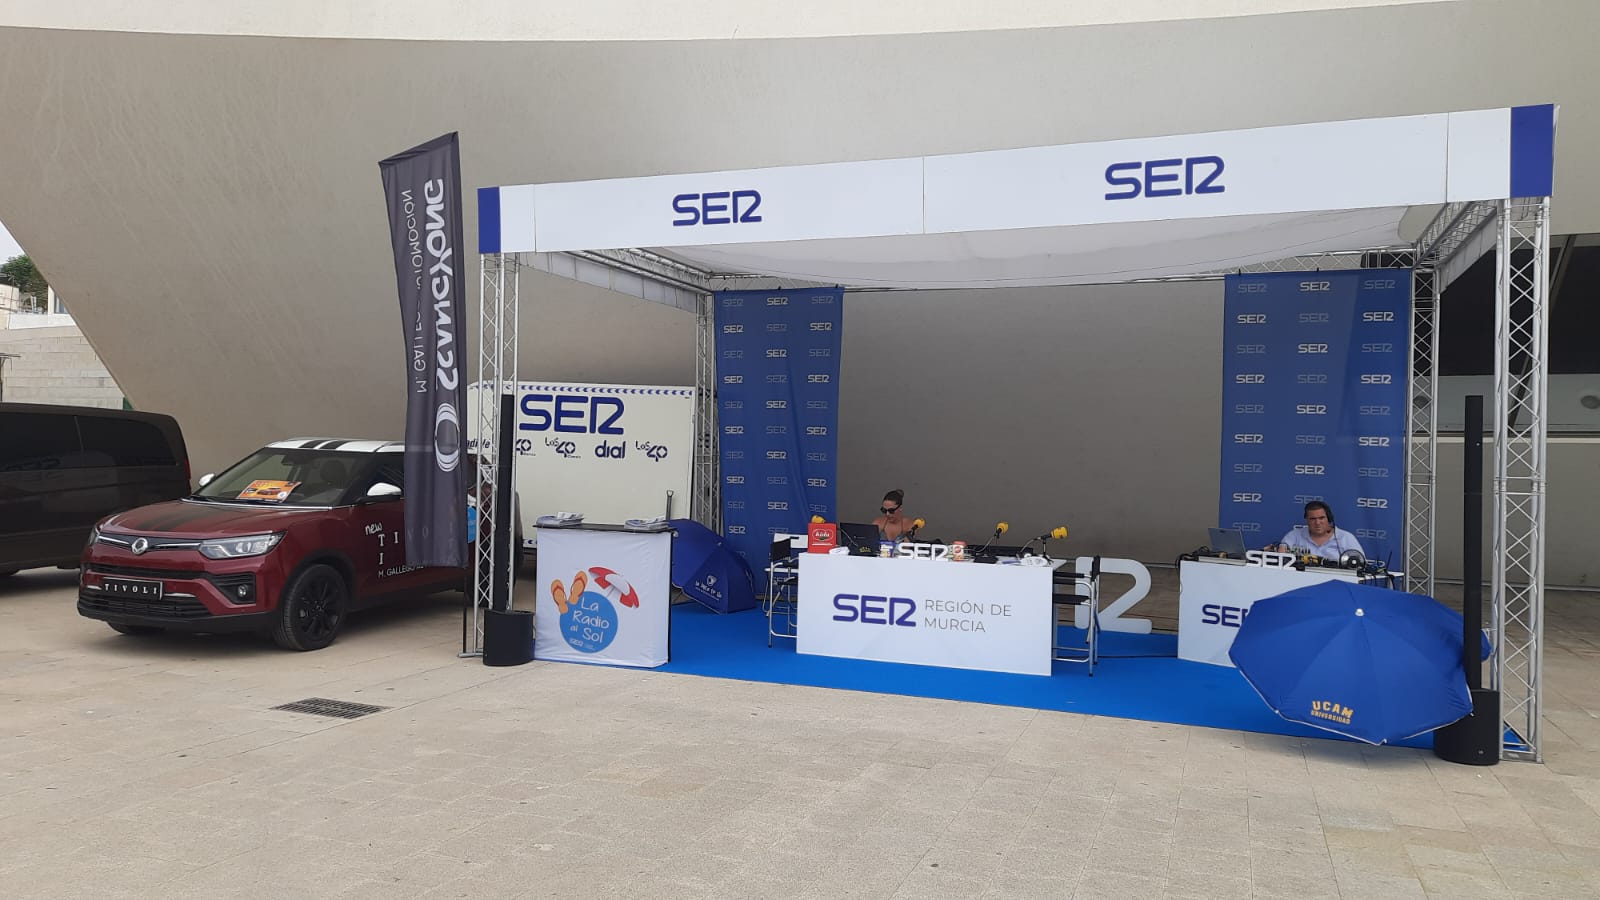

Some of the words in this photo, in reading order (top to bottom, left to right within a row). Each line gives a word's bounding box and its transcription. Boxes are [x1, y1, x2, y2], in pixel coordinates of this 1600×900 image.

[1103, 154, 1226, 200] SER
[672, 189, 762, 227] SER
[1300, 282, 1330, 291] SER
[767, 297, 788, 305] SER
[1237, 314, 1266, 323] SER
[1363, 312, 1393, 321] SER
[724, 325, 743, 333] SER
[766, 349, 786, 357] SER
[1298, 344, 1327, 353] SER
[1236, 375, 1264, 383] SER
[1361, 375, 1391, 384] SER
[519, 394, 625, 435] SER
[1297, 405, 1326, 414] SER
[725, 426, 743, 434] SER
[807, 427, 826, 435] SER
[1235, 434, 1263, 443] SER
[1359, 437, 1389, 446] SER
[595, 440, 627, 458] dial
[767, 451, 786, 459] SER
[1295, 465, 1324, 474] SER
[808, 479, 826, 487] SER
[768, 502, 788, 510] SER
[1233, 493, 1261, 502] SER
[1357, 498, 1387, 508] SER
[365, 522, 382, 535] new
[729, 526, 745, 534] SER
[898, 542, 949, 562] SER
[1245, 549, 1297, 571] SER
[104, 583, 157, 594] TIVOLI
[581, 597, 599, 612] La
[833, 593, 916, 627] SER
[925, 600, 984, 615] REGIÓN
[990, 604, 1012, 617] DE
[573, 610, 609, 629] Radio
[924, 617, 986, 633] MURCIA
[582, 627, 604, 643] Sol
[1312, 700, 1354, 718] UCAM
